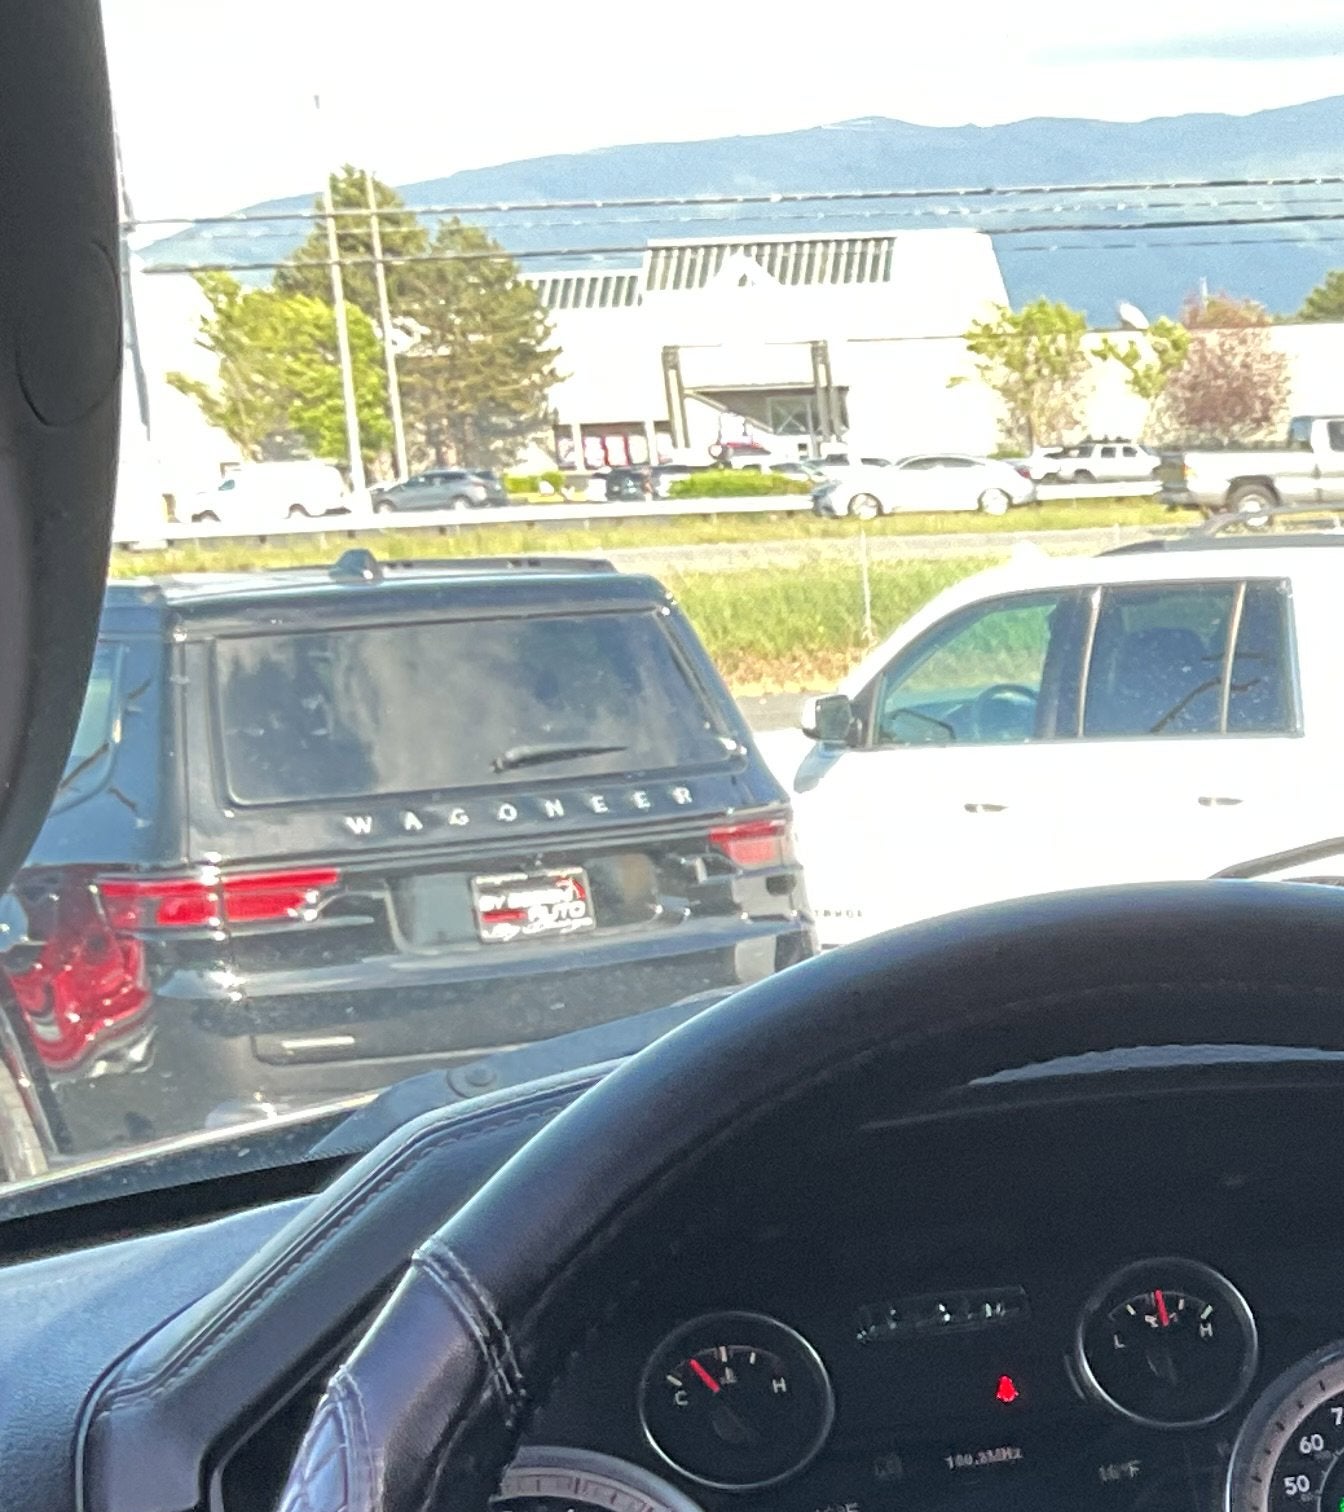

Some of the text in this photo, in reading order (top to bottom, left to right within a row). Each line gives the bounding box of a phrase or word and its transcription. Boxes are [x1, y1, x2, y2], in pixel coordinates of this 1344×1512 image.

[346, 786, 692, 835] WAGONEER
[1200, 1322, 1214, 1338] H
[772, 1377, 787, 1393] H
[1299, 1434, 1324, 1454] 60
[1284, 1475, 1310, 1495] 50
